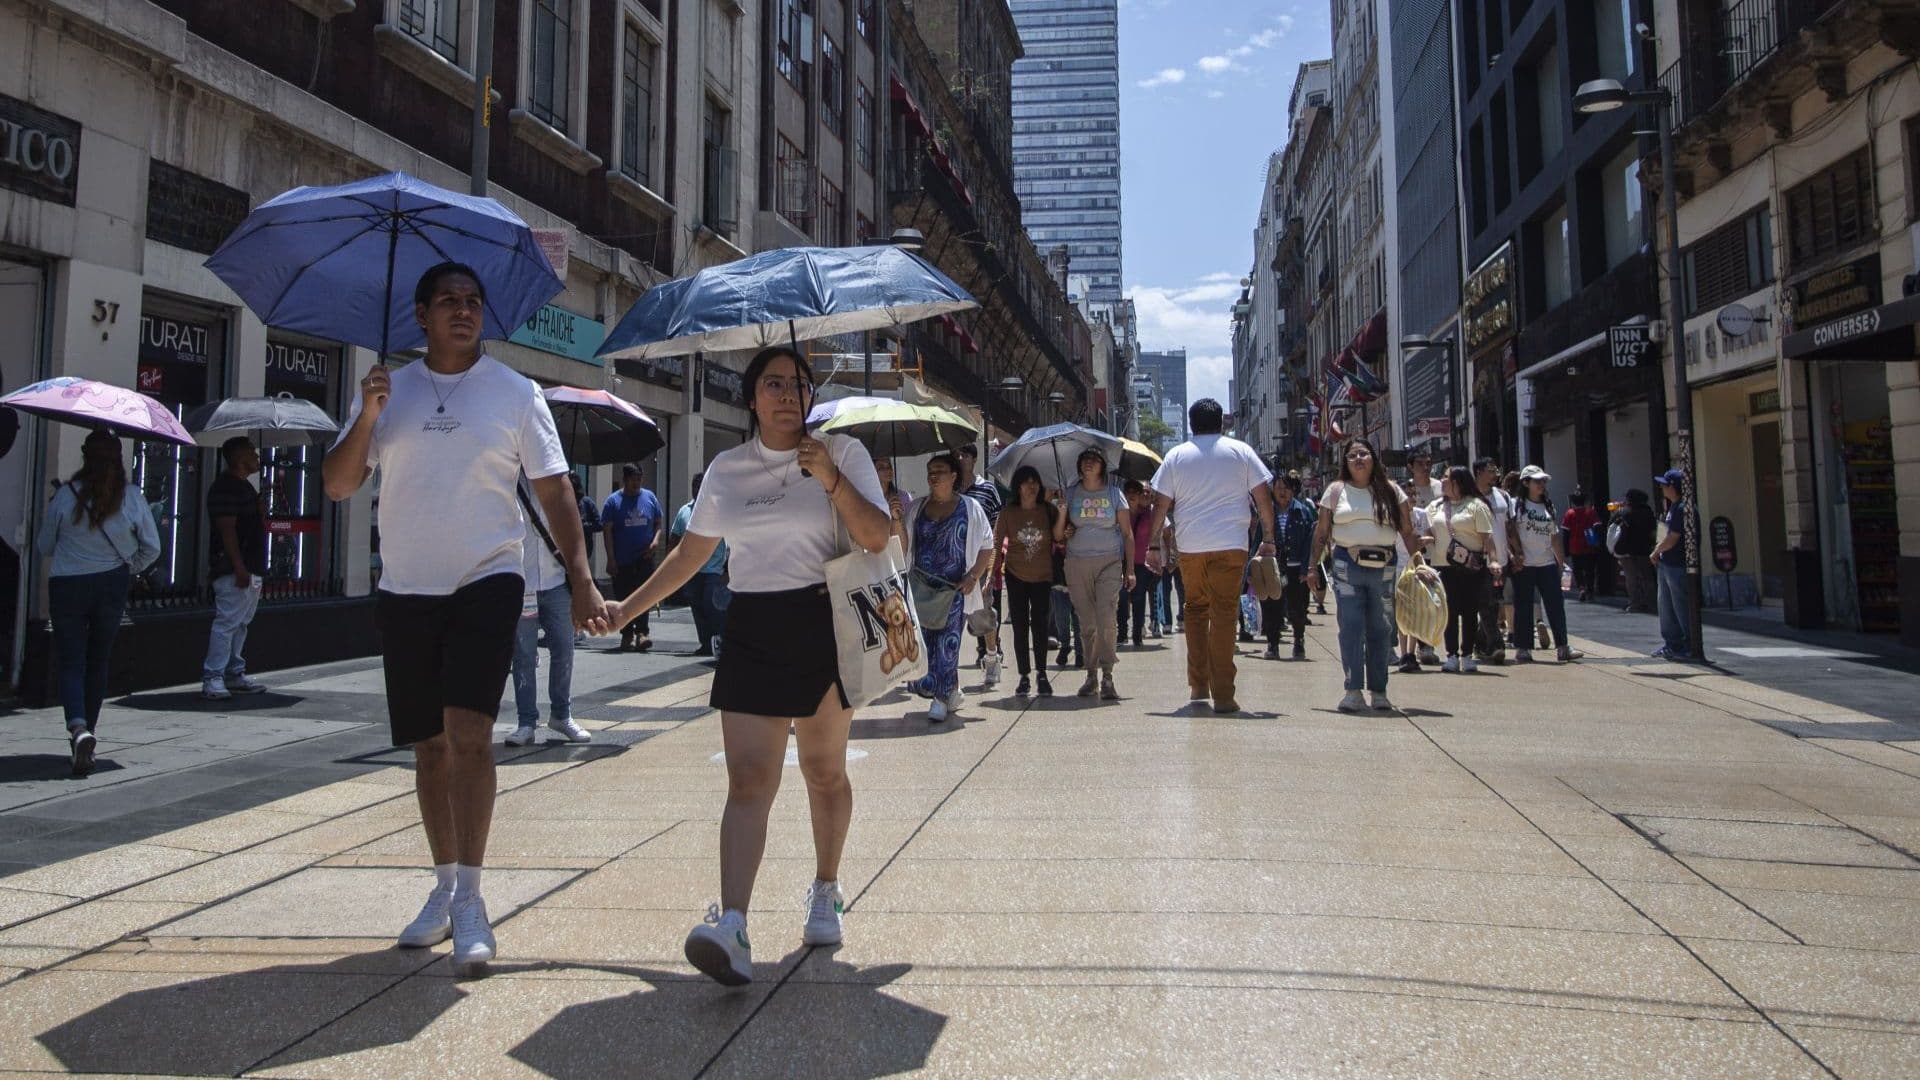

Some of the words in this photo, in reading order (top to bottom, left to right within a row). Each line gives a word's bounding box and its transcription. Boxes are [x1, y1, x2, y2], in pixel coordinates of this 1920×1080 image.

[0, 119, 73, 179] ICO
[92, 299, 120, 324] 37
[537, 306, 576, 345] FRAICHE
[140, 316, 208, 355] TURATI
[1614, 329, 1641, 341] INN
[1814, 314, 1870, 346] CONVERSE
[275, 345, 328, 377] TURATI
[1615, 342, 1649, 354] VICT
[1616, 355, 1637, 367] US
